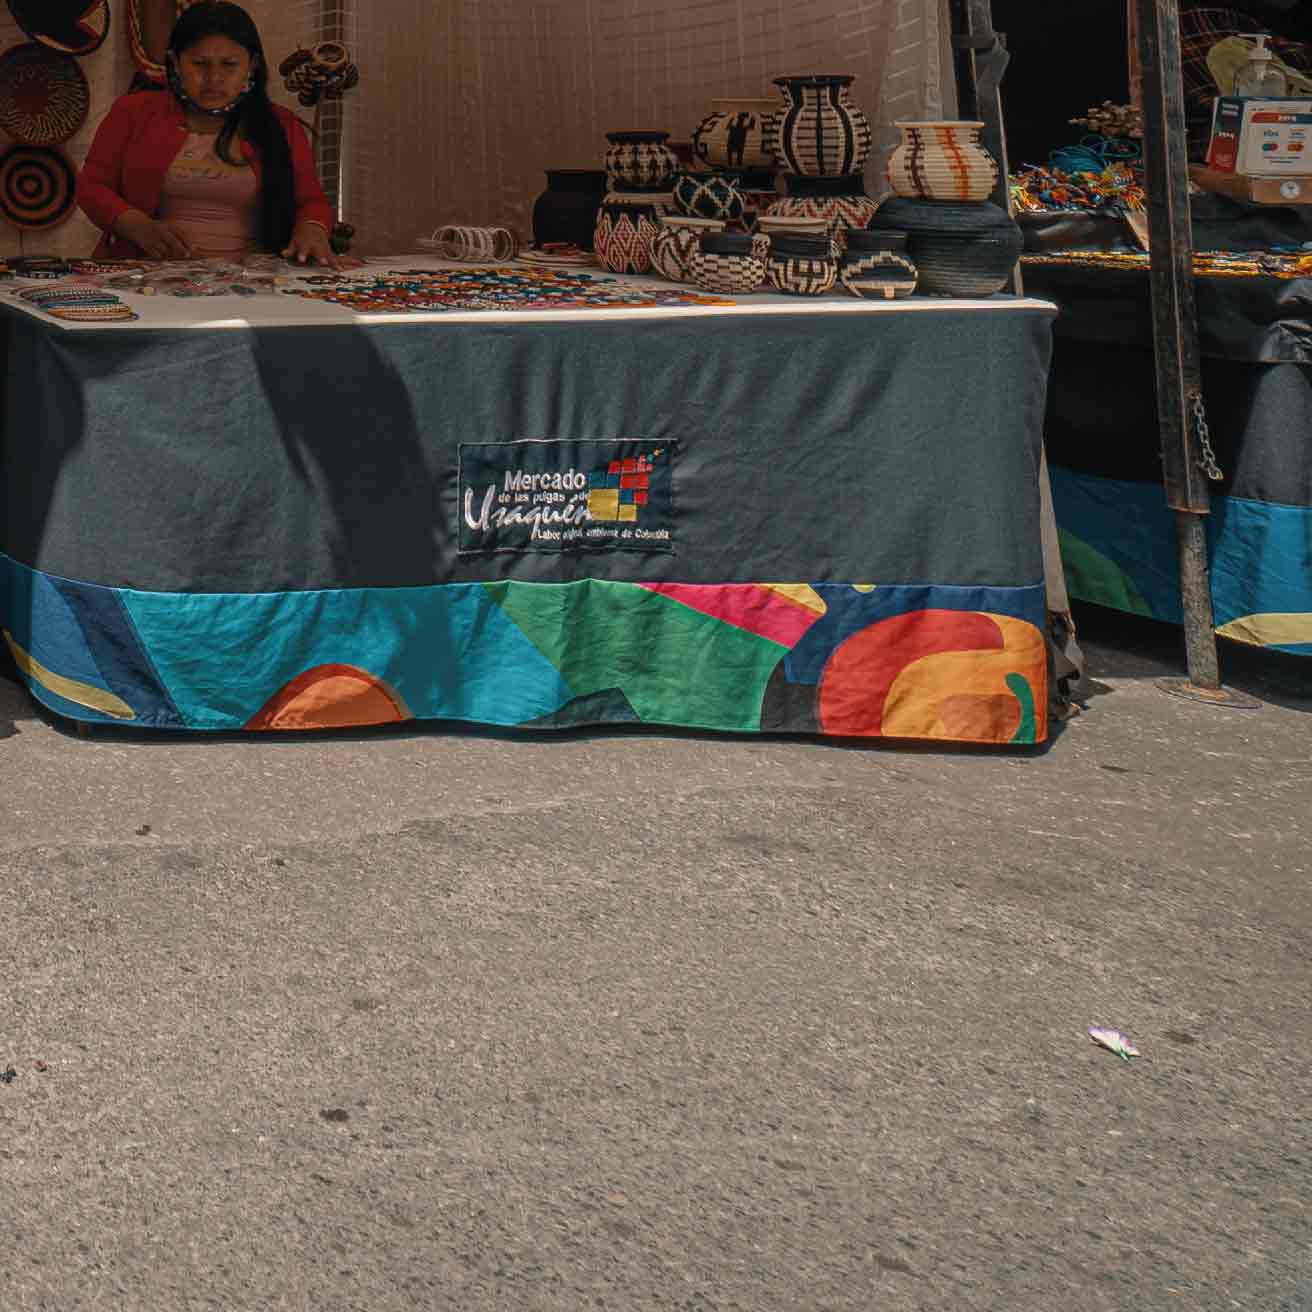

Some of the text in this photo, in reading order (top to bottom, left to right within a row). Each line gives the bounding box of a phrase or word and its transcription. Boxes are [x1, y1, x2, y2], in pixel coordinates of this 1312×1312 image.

[504, 468, 586, 491] Mercado
[498, 492, 511, 503] de
[514, 492, 529, 503] las
[532, 491, 566, 506] pulgas
